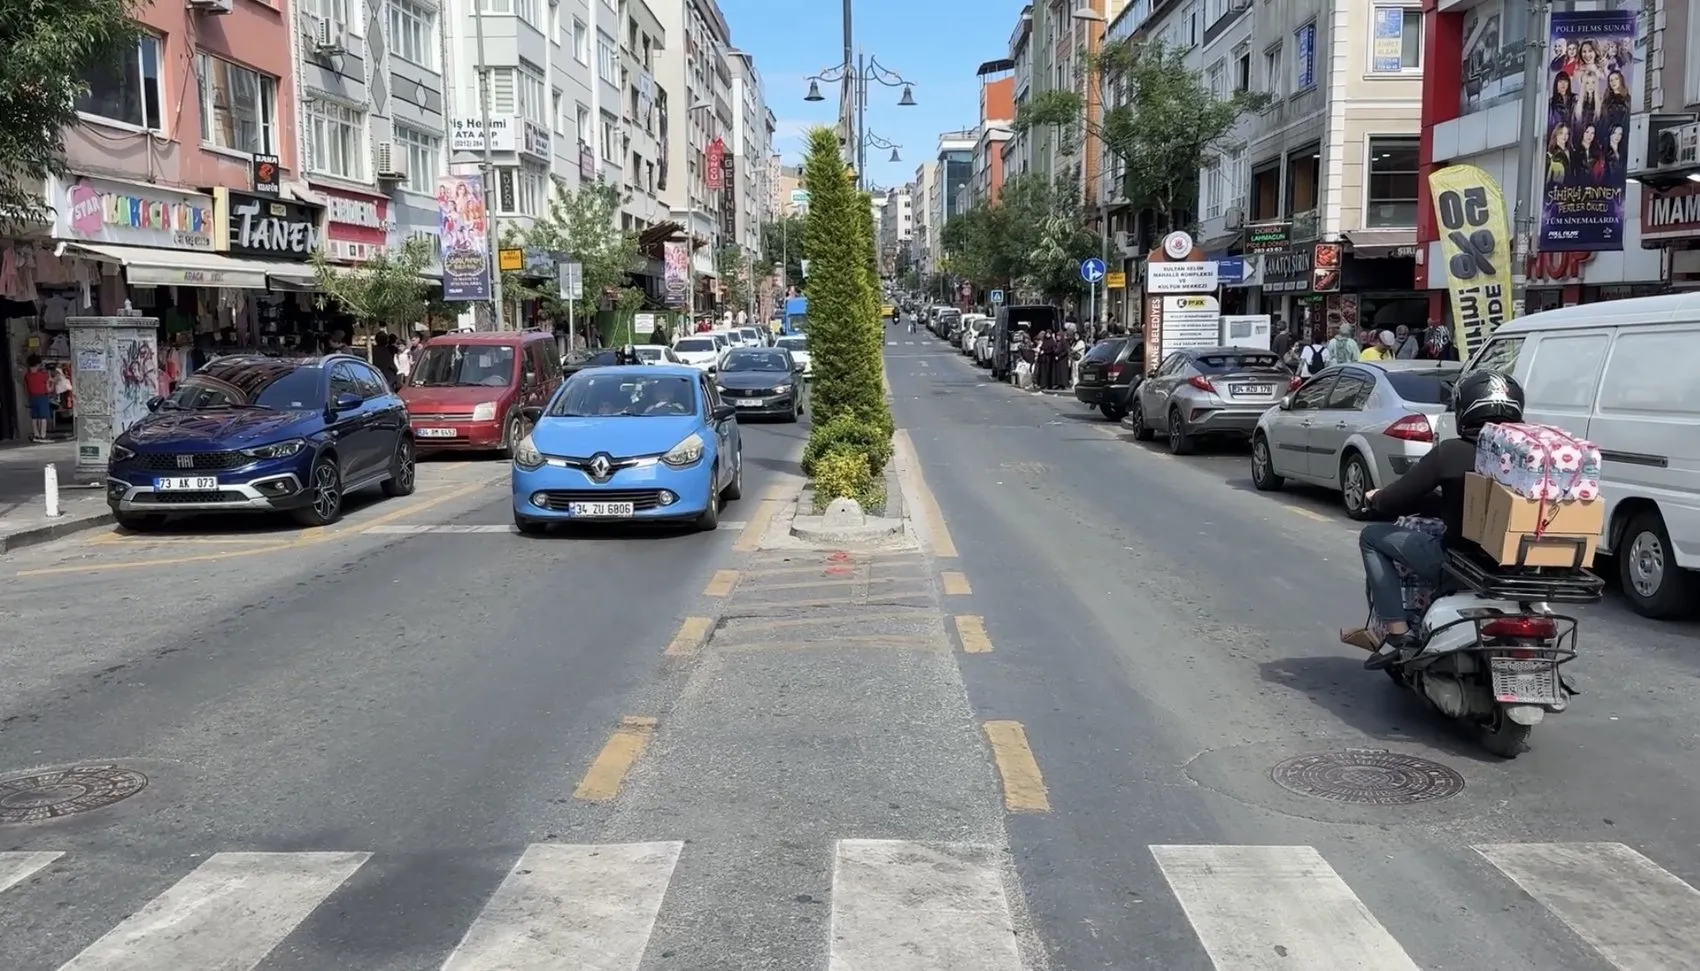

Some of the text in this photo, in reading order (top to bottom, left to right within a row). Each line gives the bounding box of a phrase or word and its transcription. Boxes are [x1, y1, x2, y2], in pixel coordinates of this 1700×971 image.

[1556, 25, 1575, 33] POLL
[1604, 24, 1631, 32] SUNAR
[466, 119, 507, 128] Heimi
[75, 196, 100, 221] STAR
[101, 192, 171, 231] KARACA
[1546, 216, 1620, 225] TÜM SİNEMALARDA
[1250, 233, 1286, 242] LAHMACUN
[176, 454, 195, 468] FIAT
[160, 478, 214, 489] 73 AK 073
[577, 503, 631, 514] 34 ZU 6806
